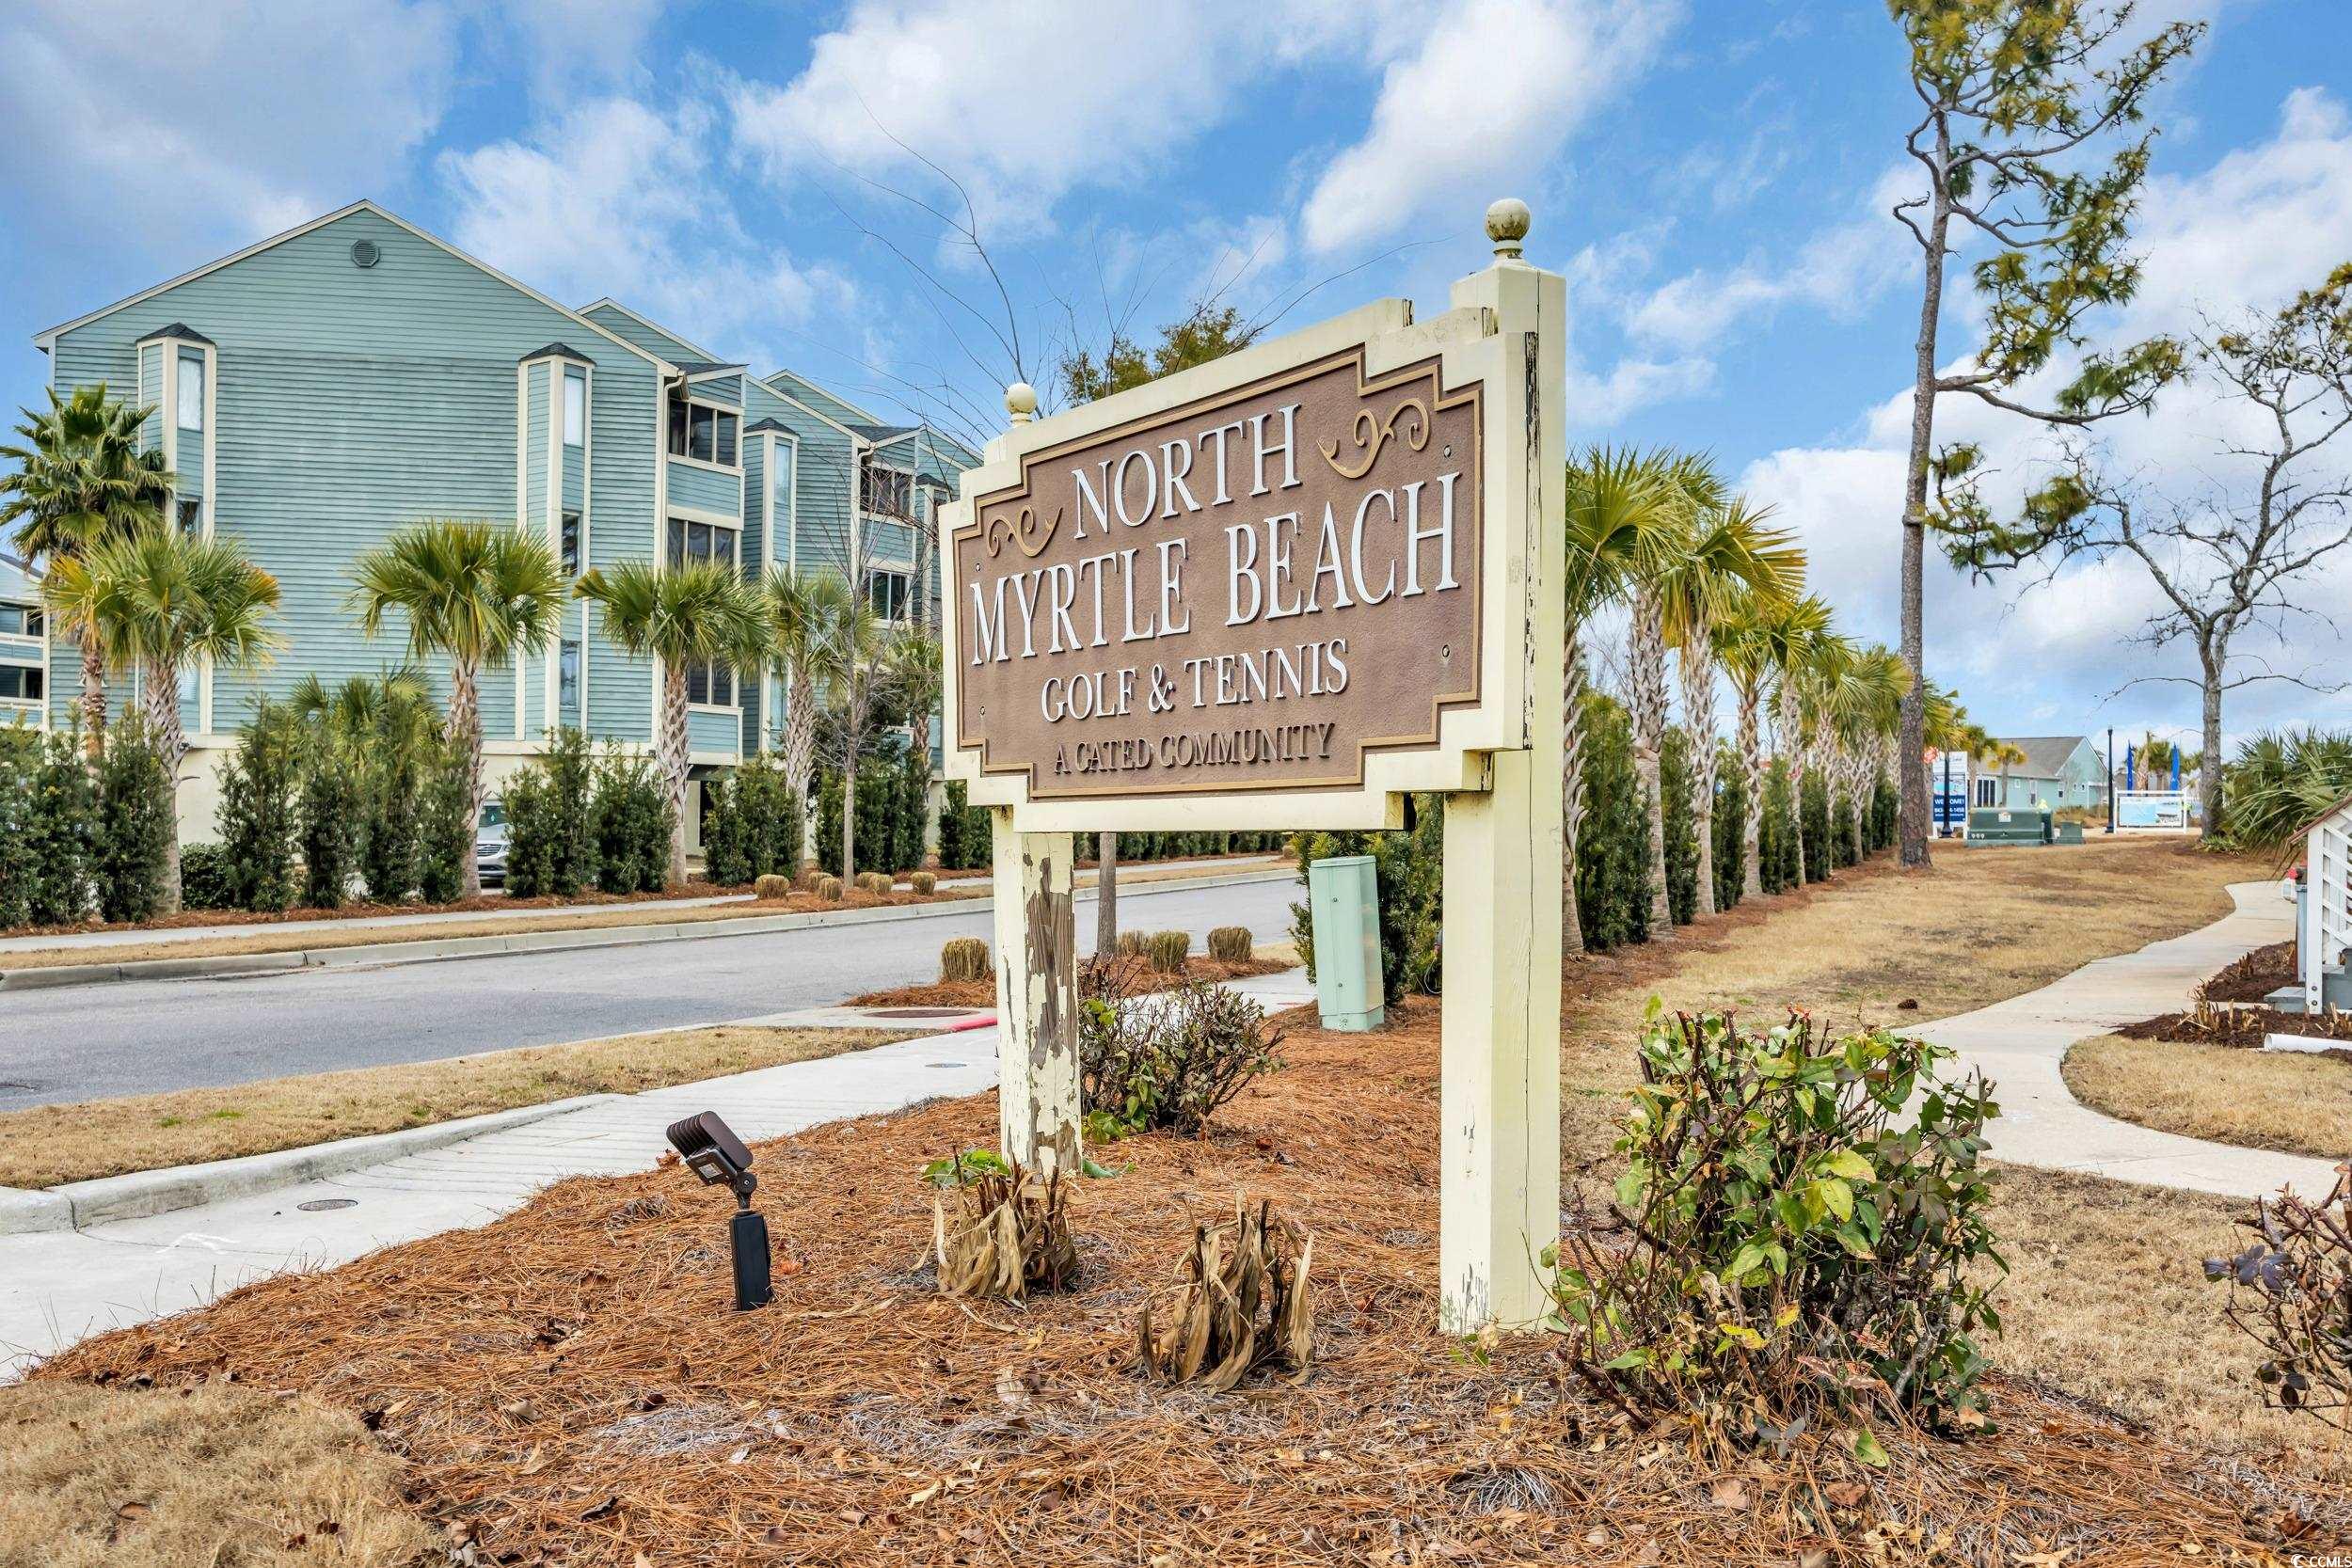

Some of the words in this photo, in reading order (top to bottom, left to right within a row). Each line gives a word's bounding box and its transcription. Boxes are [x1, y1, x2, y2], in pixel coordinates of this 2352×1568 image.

[1072, 404, 1302, 541] NORTH
[970, 537, 1191, 666] MYRTLE
[1225, 472, 1461, 627] BEACH
[1041, 668, 1136, 723] GOLF
[1148, 664, 1174, 713] &
[1184, 639, 1348, 710] TENNIS
[1054, 743, 1073, 775] A
[1075, 737, 1154, 773] GATED
[1160, 722, 1336, 768] COMMUNITY
